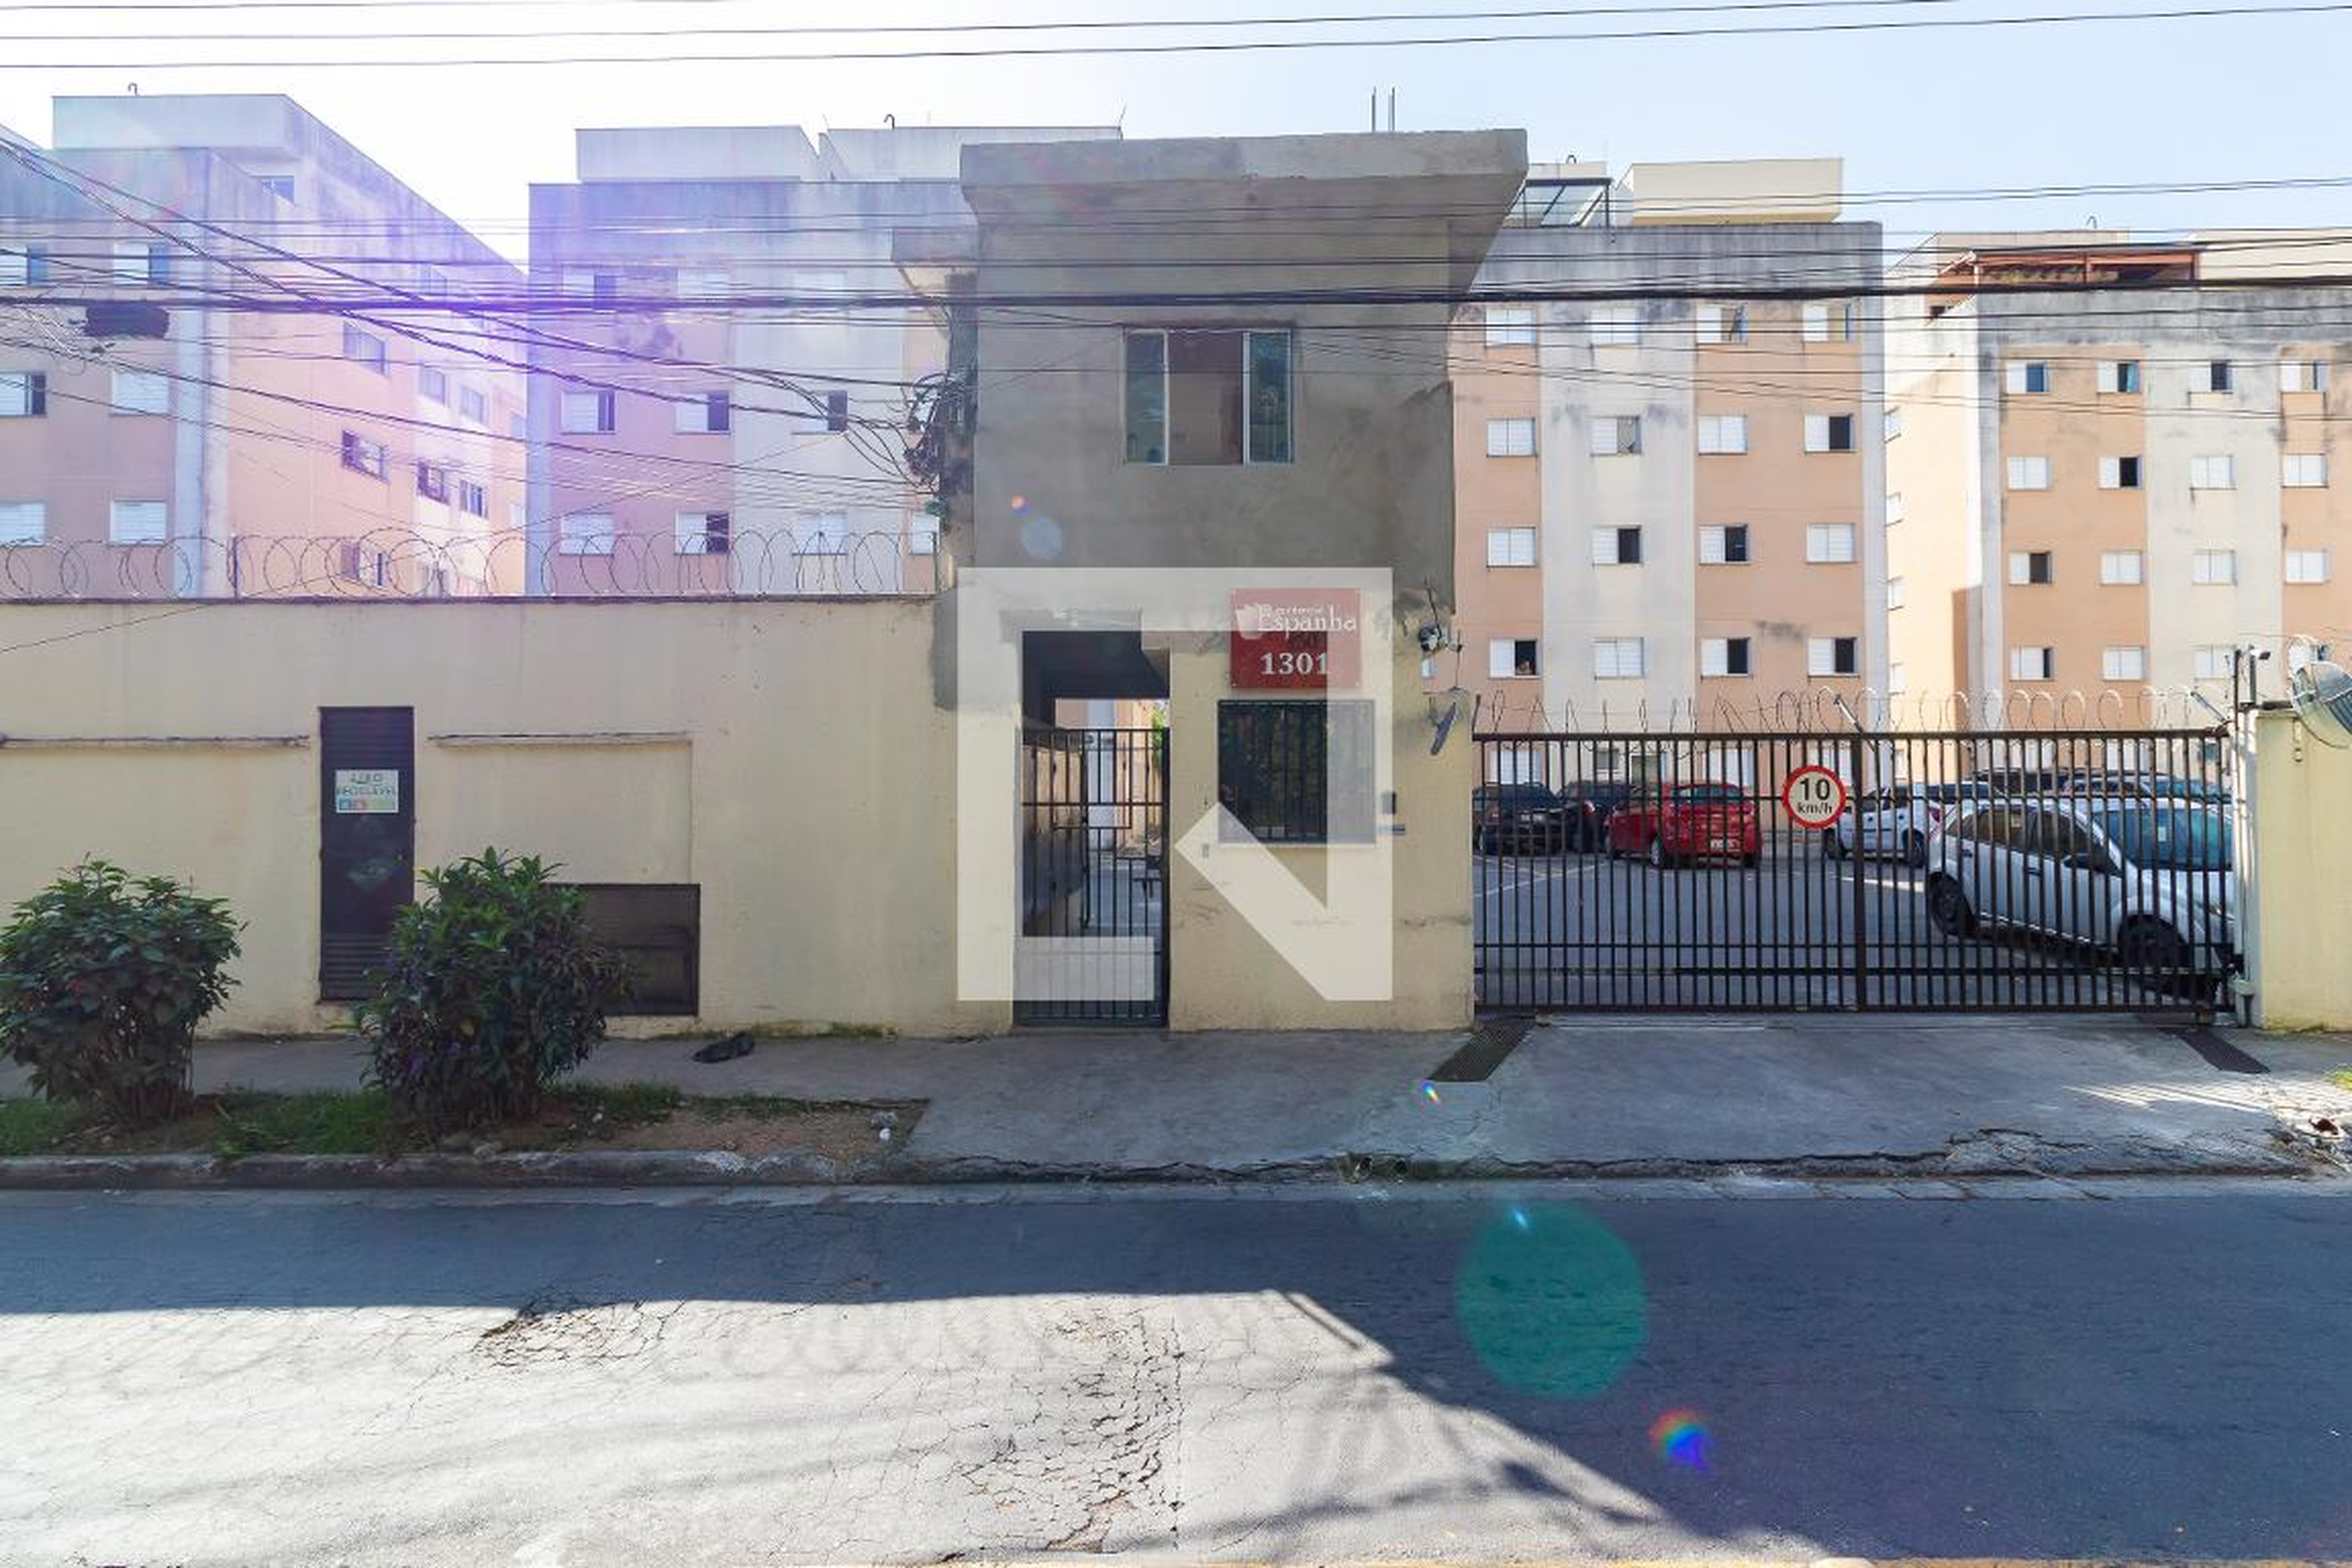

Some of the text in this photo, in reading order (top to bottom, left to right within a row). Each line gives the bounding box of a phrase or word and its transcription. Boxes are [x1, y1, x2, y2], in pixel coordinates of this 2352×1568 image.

[1257, 605, 1357, 639] Espanha
[1260, 652, 1330, 674] 1301
[1800, 778, 1830, 801] 10
[1797, 802, 1832, 814] km/h
